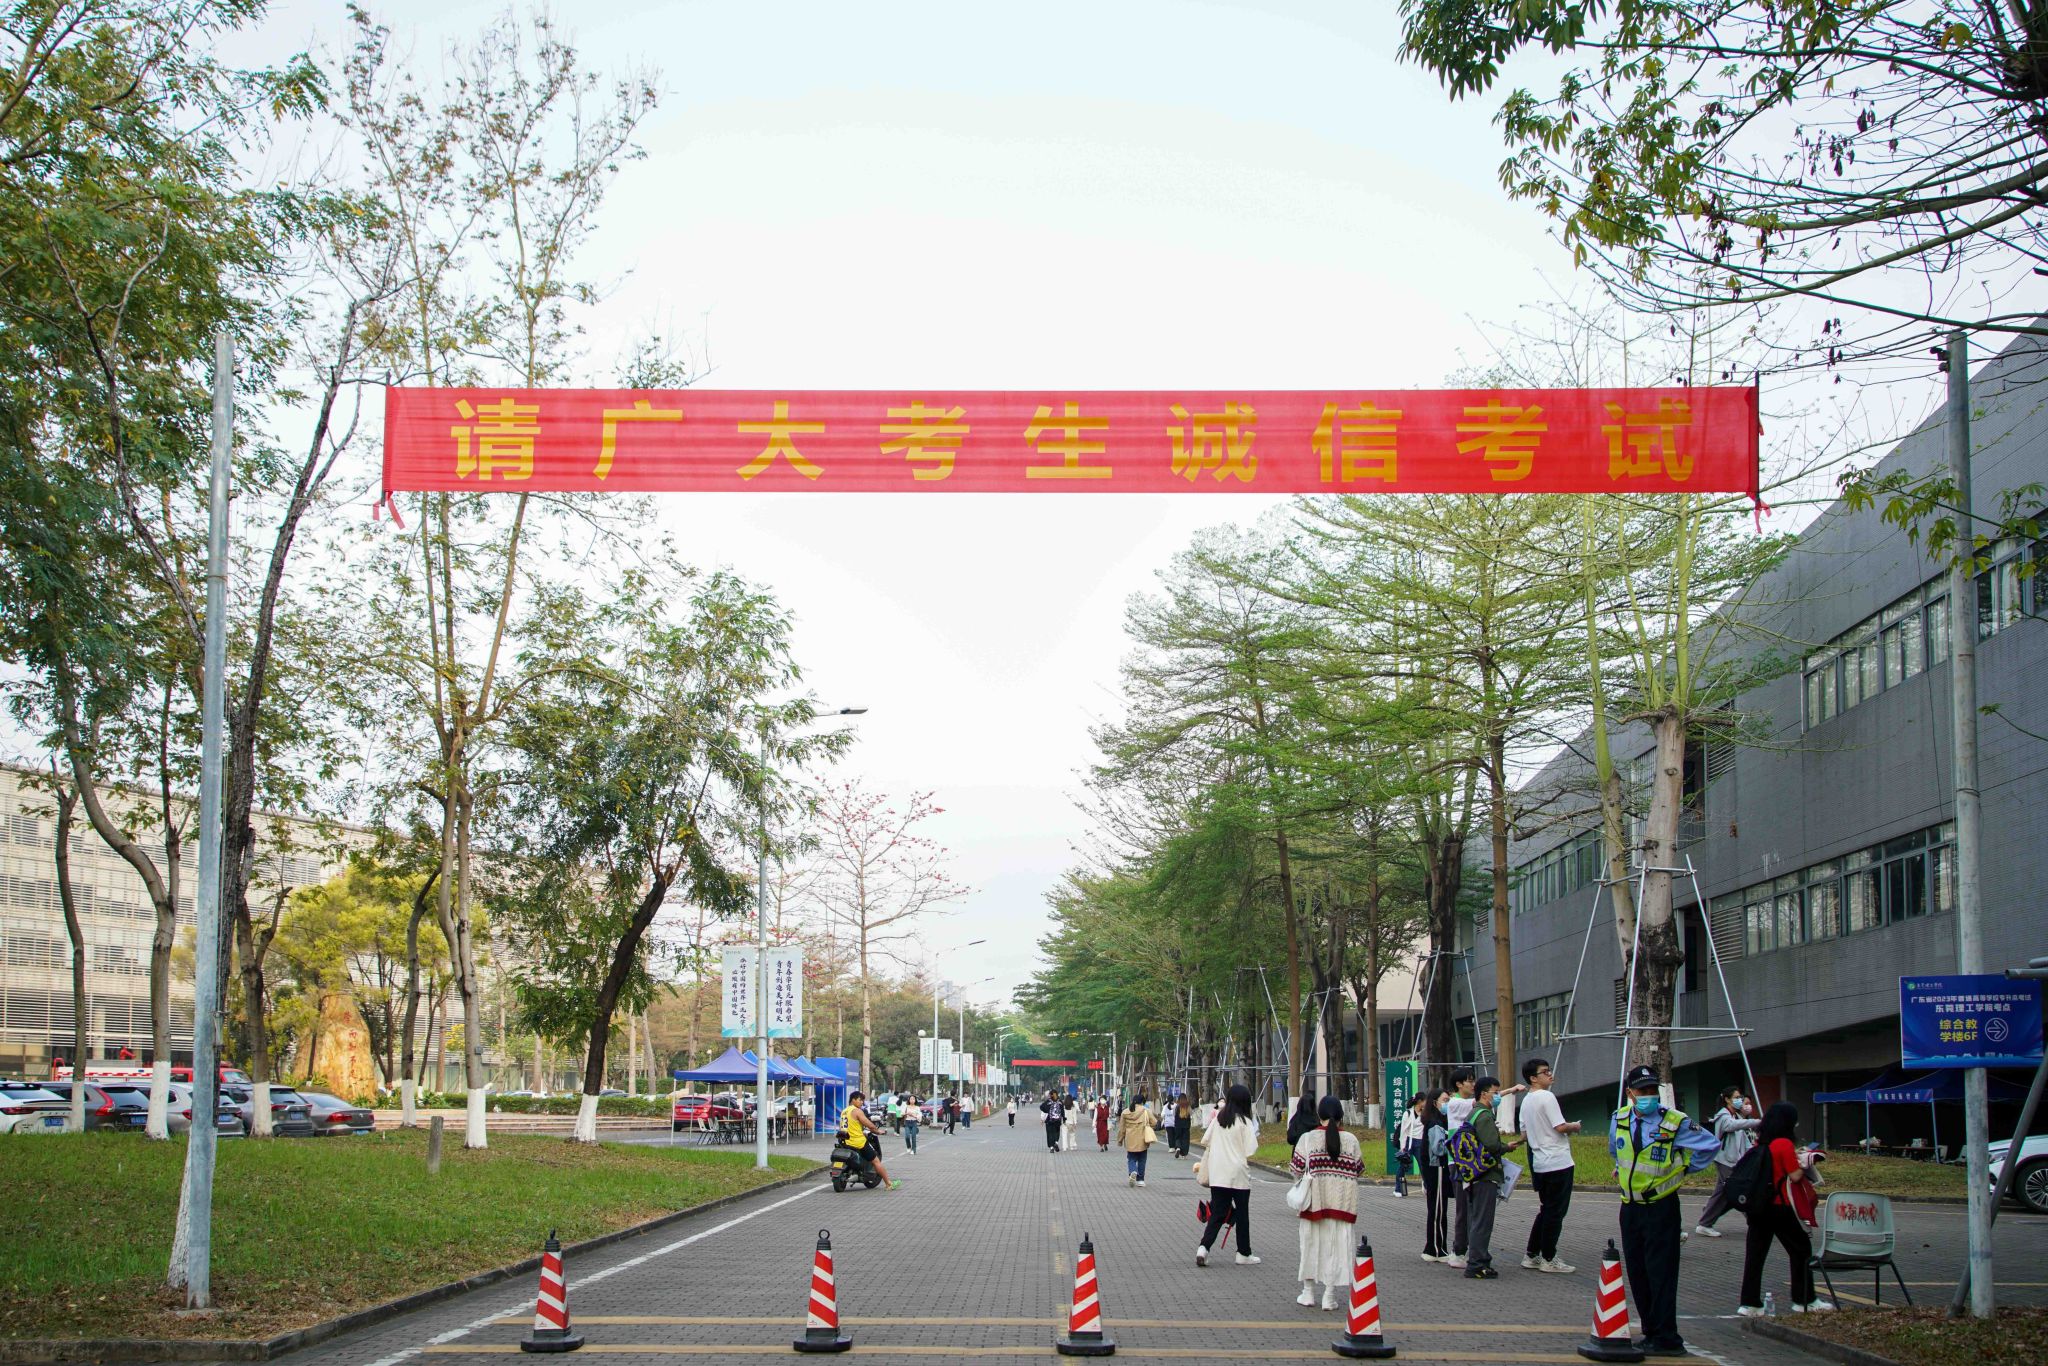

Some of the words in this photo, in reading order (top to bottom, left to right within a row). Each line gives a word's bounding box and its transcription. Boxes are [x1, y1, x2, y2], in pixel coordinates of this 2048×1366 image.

[450, 398, 1695, 483] 请广大考生诚信考试
[1935, 1003, 2011, 1013] 东莞理工学院考点
[1939, 1018, 1978, 1030] 综合教
[1939, 1031, 1978, 1042] 学楼6F
